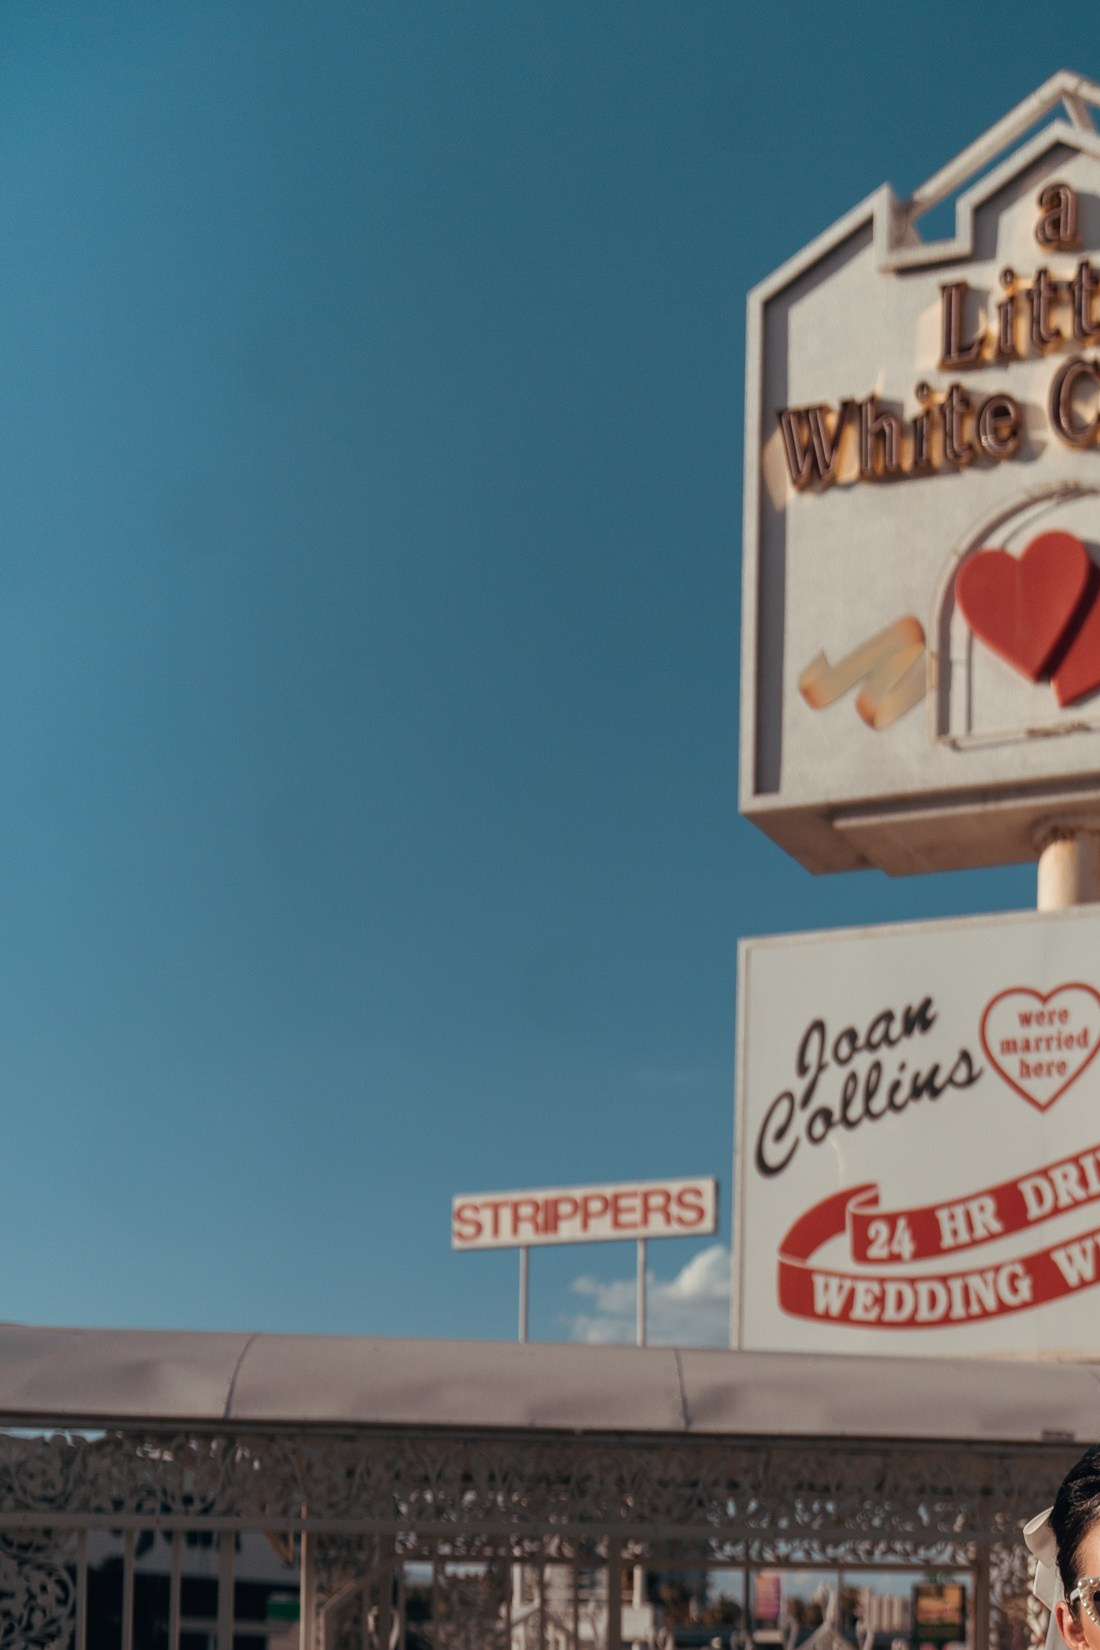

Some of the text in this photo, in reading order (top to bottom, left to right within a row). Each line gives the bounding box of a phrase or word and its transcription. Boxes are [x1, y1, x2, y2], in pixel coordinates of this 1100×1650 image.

[1035, 182, 1079, 250] a
[777, 380, 1021, 488] White
[1000, 1026, 1089, 1056] married
[1018, 1007, 1069, 1028] were
[795, 996, 937, 1108] Joan
[1018, 1058, 1067, 1080] here
[755, 1047, 984, 1177] Collins
[454, 1187, 706, 1242] STRIPPERS
[866, 1218, 916, 1259] 24
[937, 1200, 1004, 1248] HR
[811, 1262, 1034, 1322] WEDDING
